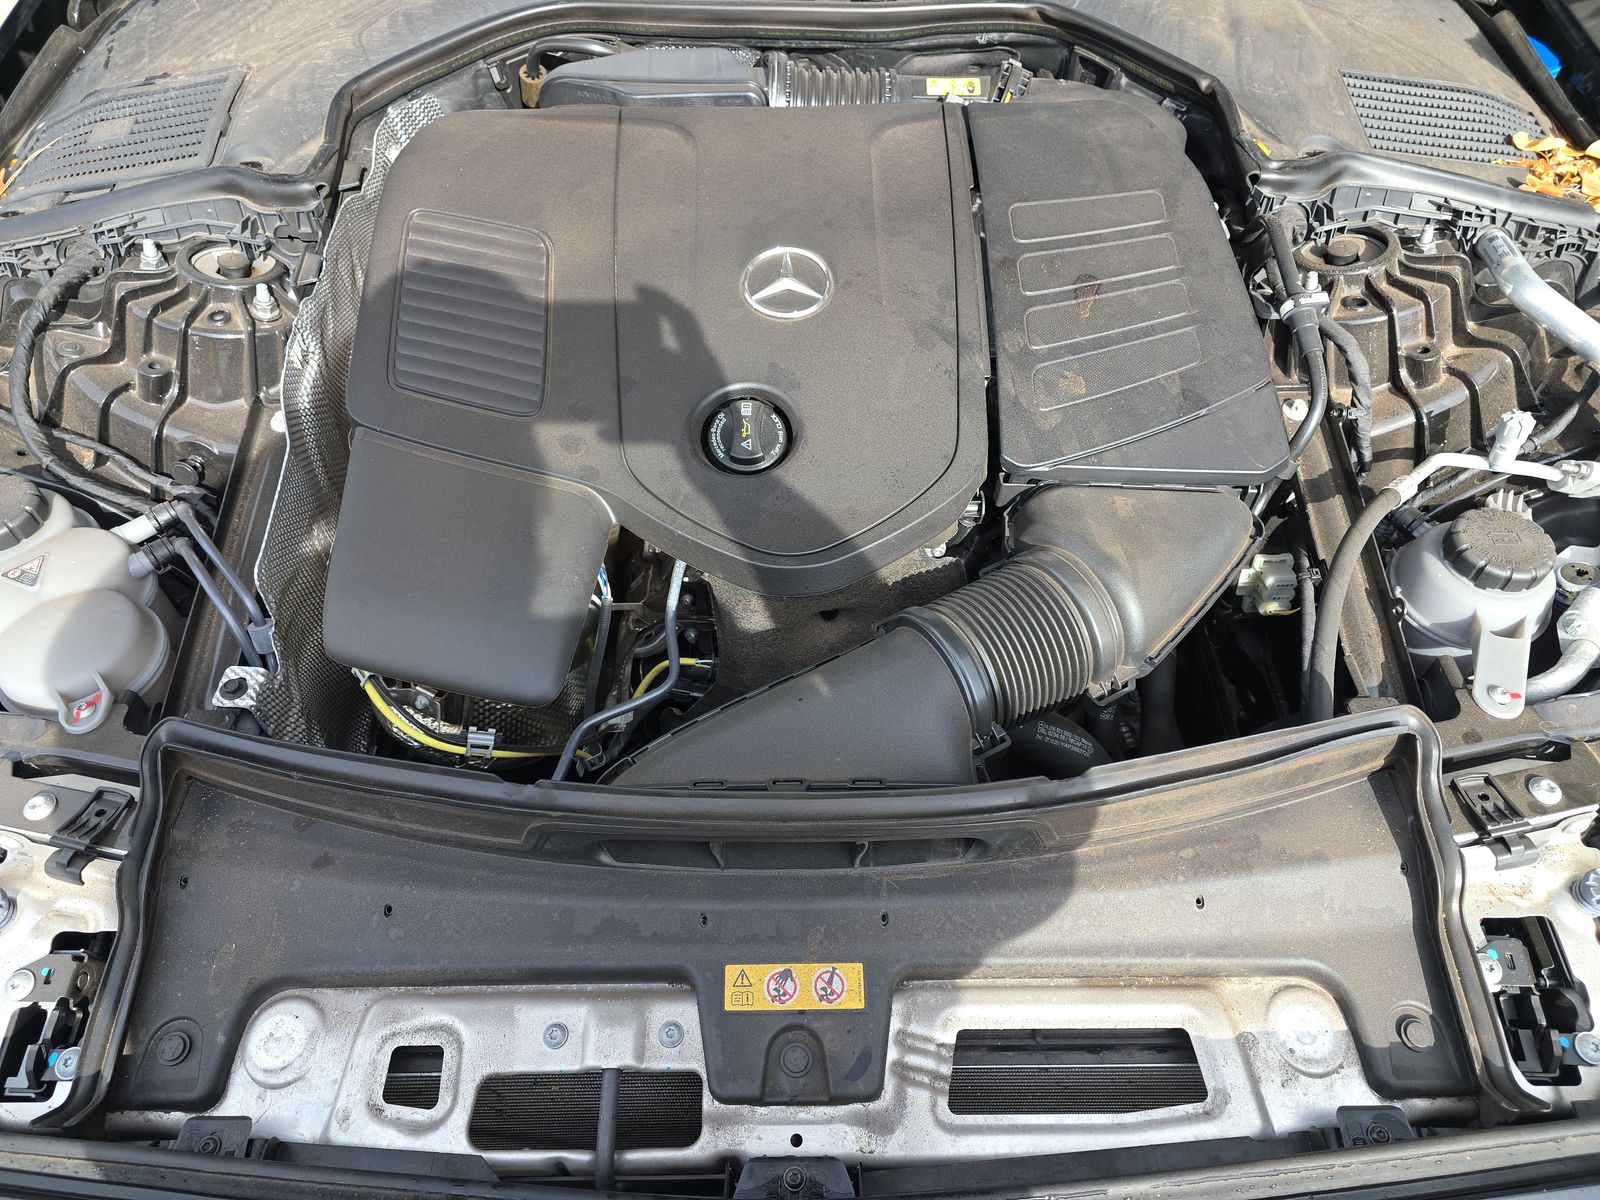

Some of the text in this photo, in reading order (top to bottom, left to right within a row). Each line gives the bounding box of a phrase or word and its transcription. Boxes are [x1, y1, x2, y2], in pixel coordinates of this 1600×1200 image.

[770, 413, 783, 429] CLICK
[711, 412, 726, 459] Mercedes-Benz Oil
[716, 417, 727, 452] recommended
[770, 443, 782, 456] Turn
